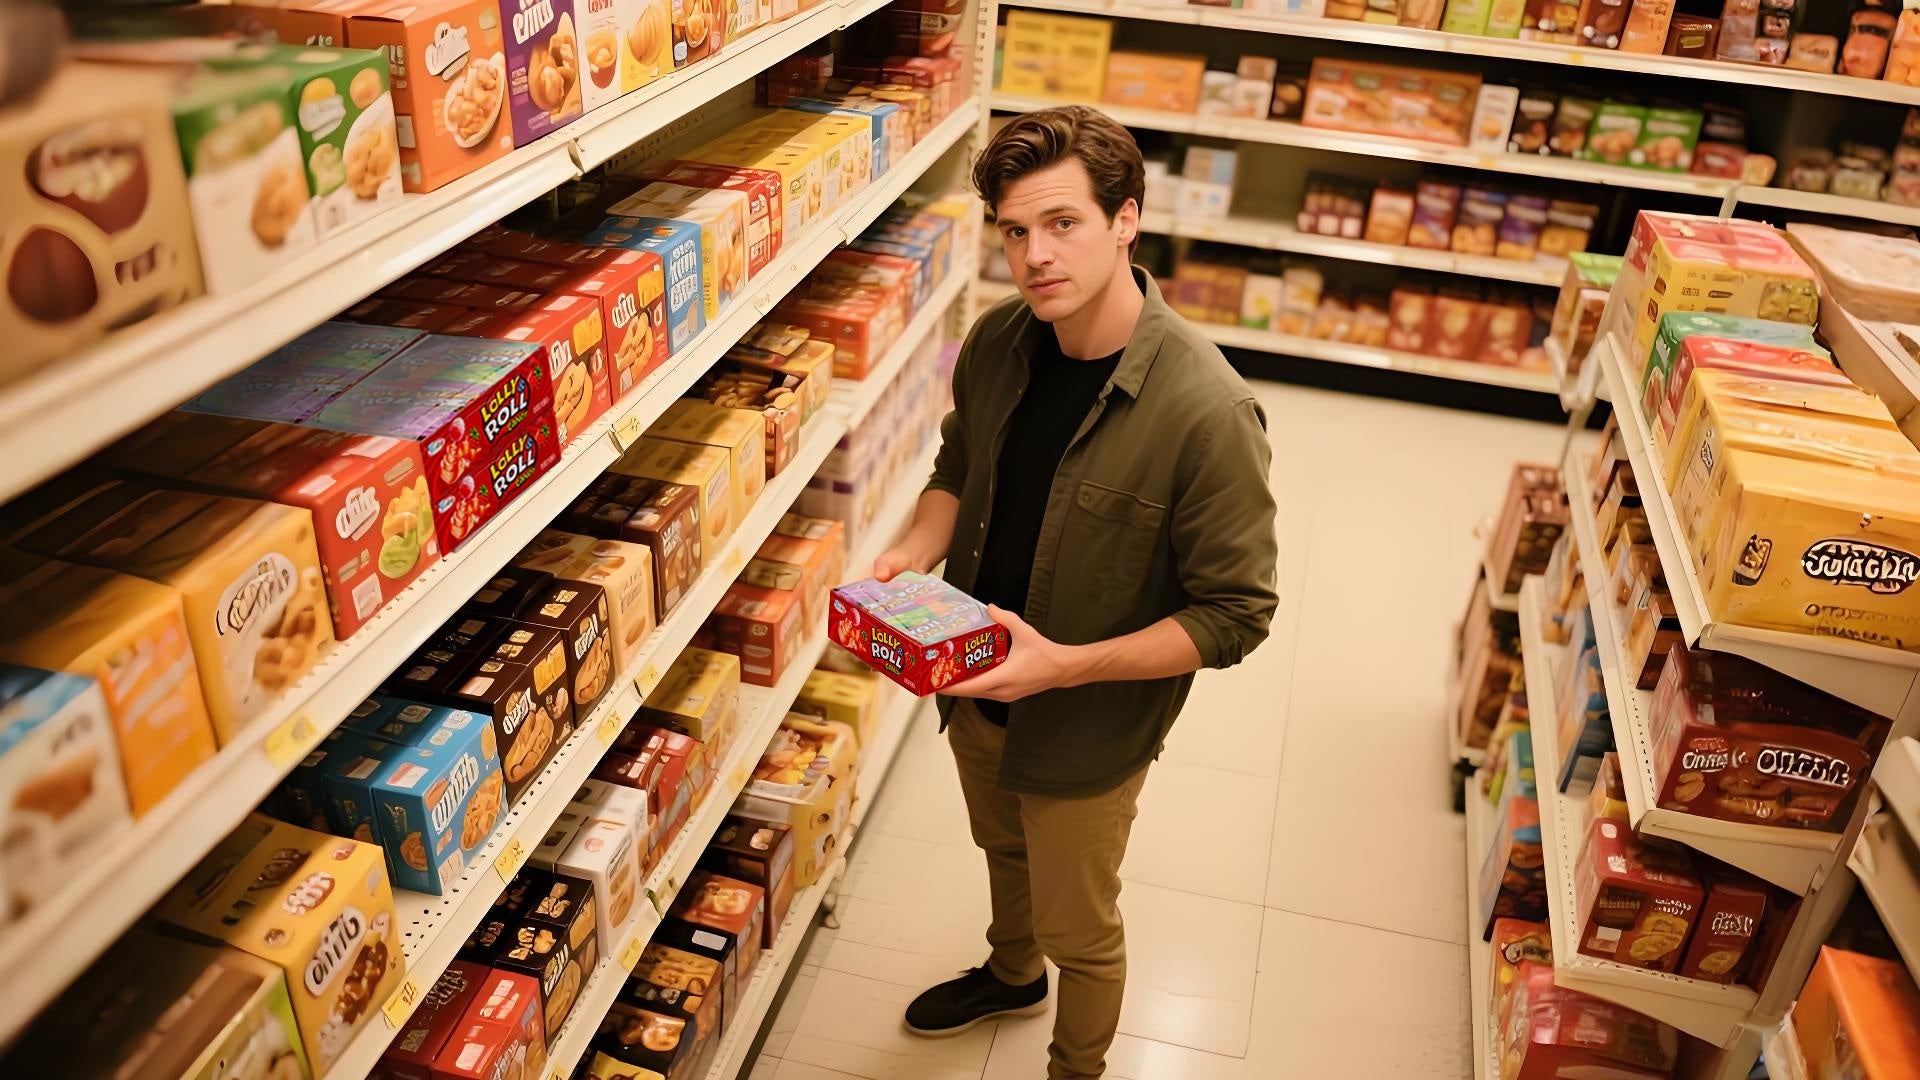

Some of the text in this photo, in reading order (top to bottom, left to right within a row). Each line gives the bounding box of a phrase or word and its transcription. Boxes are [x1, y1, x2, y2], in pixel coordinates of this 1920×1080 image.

[481, 375, 520, 422] LOLLY
[484, 393, 528, 441] ROLL
[490, 434, 528, 479] LOLLY
[493, 450, 535, 497] ROLL
[871, 627, 901, 649] LOLLY
[871, 642, 902, 669] ROLL
[965, 632, 992, 653] LOLLY
[965, 644, 993, 669] ROLL
